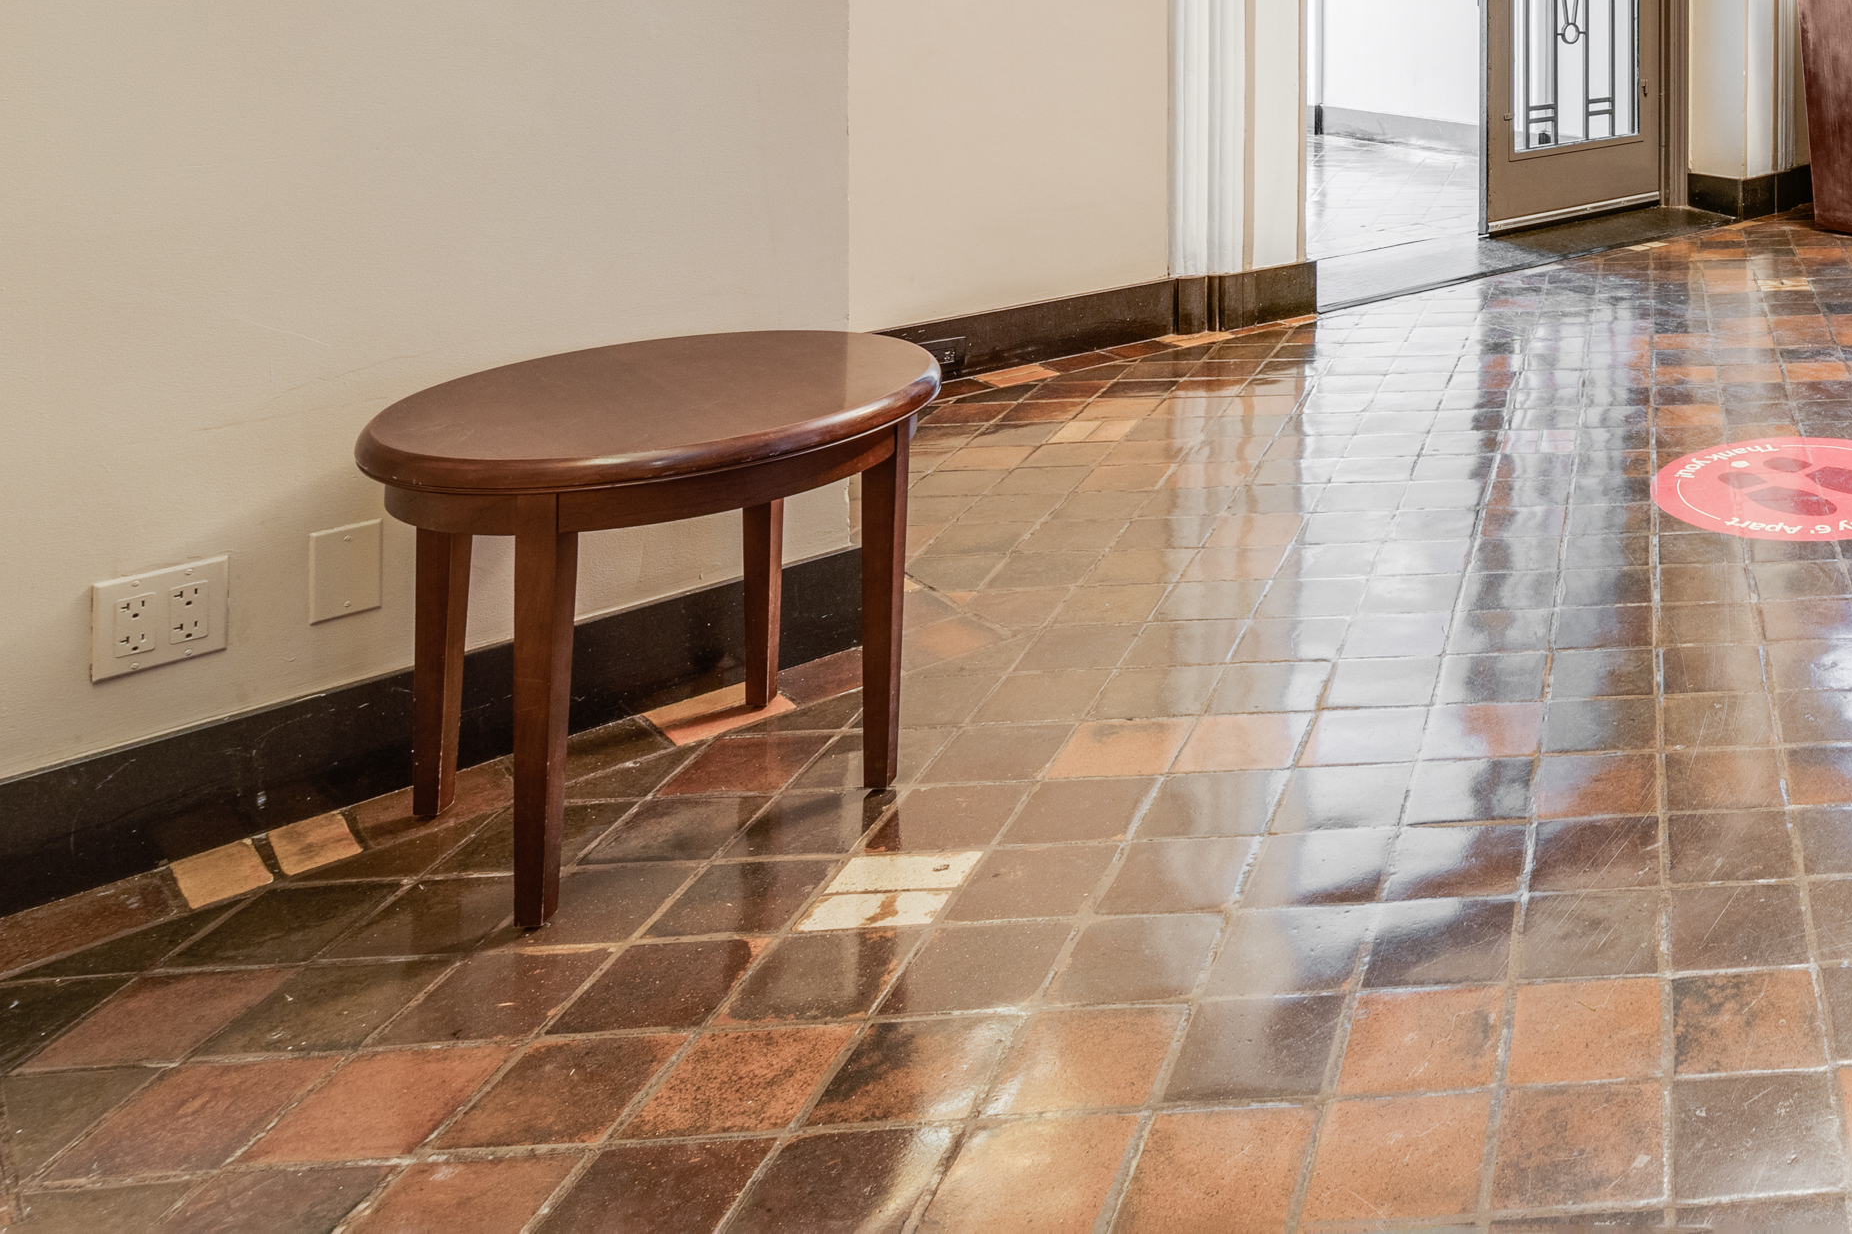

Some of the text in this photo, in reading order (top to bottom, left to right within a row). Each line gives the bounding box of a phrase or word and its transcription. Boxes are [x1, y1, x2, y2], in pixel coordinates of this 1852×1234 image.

[1673, 443, 1780, 479] Thank you!
[1724, 516, 1804, 535] Apart
[1809, 524, 1832, 535] 6'
